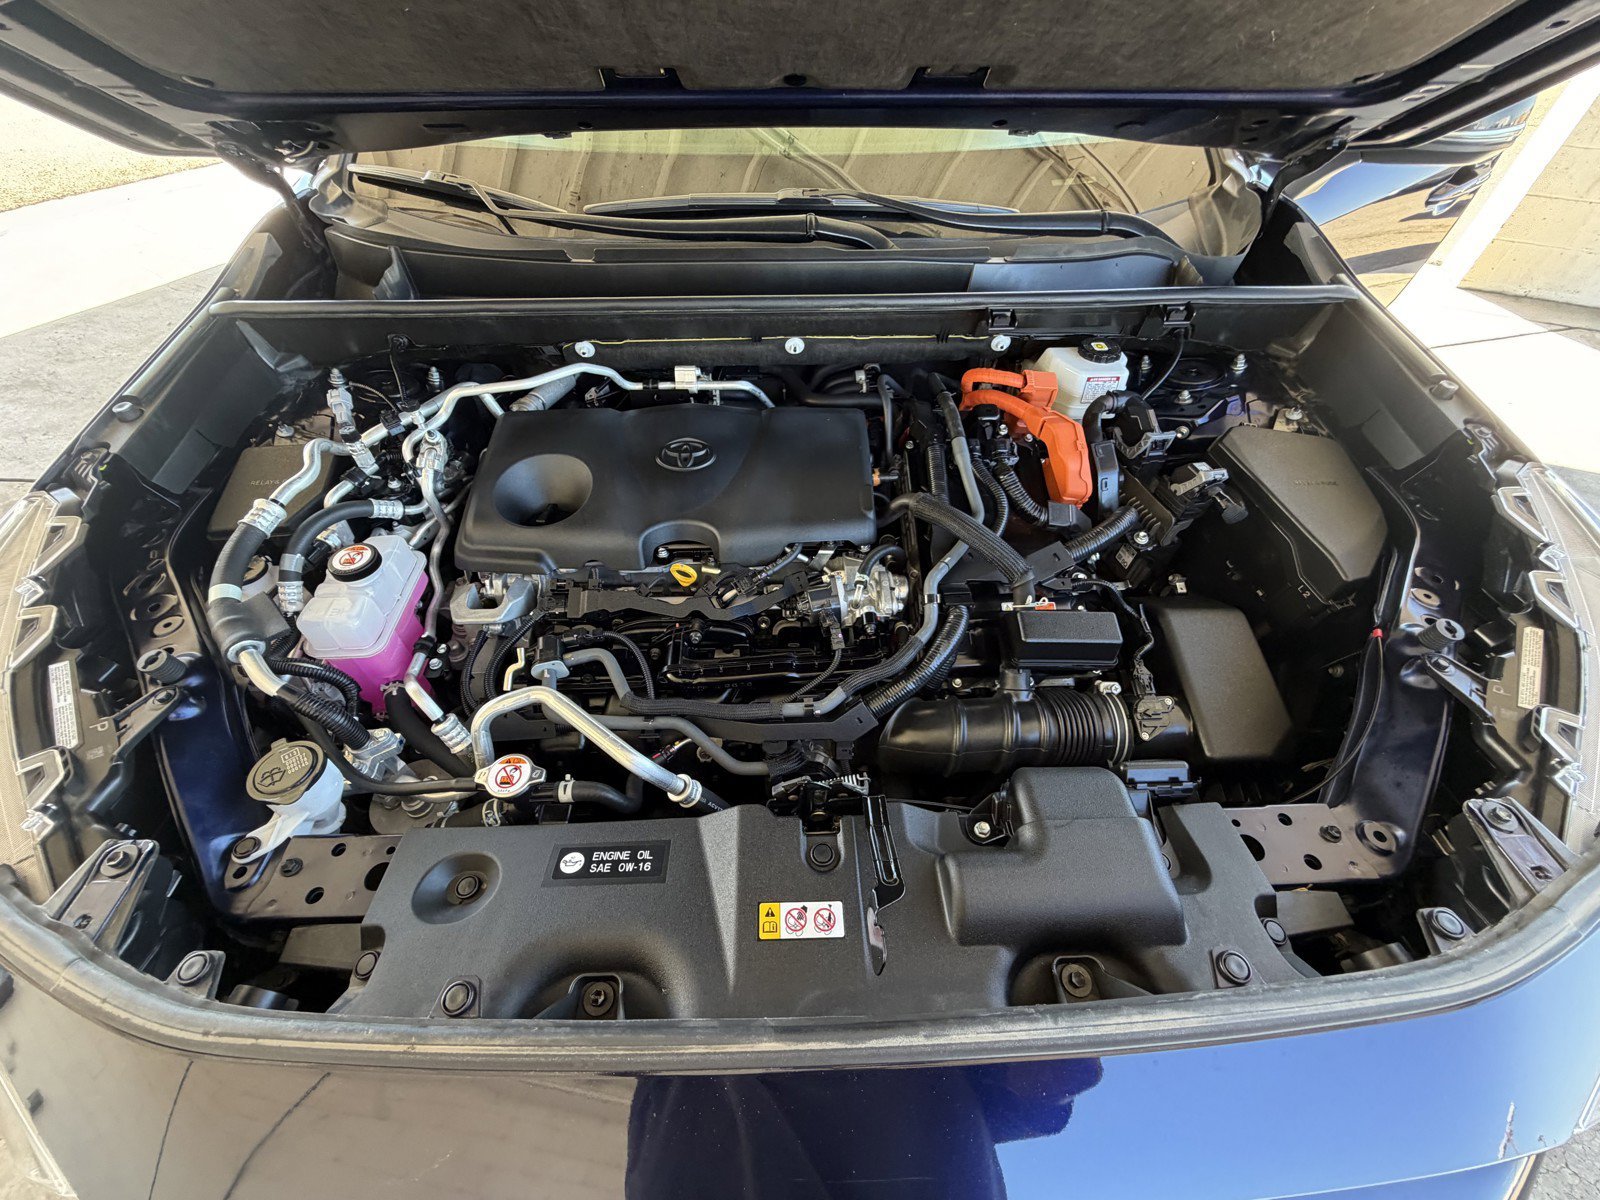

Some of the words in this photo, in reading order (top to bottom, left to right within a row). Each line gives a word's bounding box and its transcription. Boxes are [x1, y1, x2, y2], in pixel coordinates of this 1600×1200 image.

[89, 720, 109, 732] P
[592, 850, 631, 861] ENGINE
[637, 850, 653, 860] OIL
[589, 863, 612, 873] SAE
[618, 862, 652, 872] 0W-16
